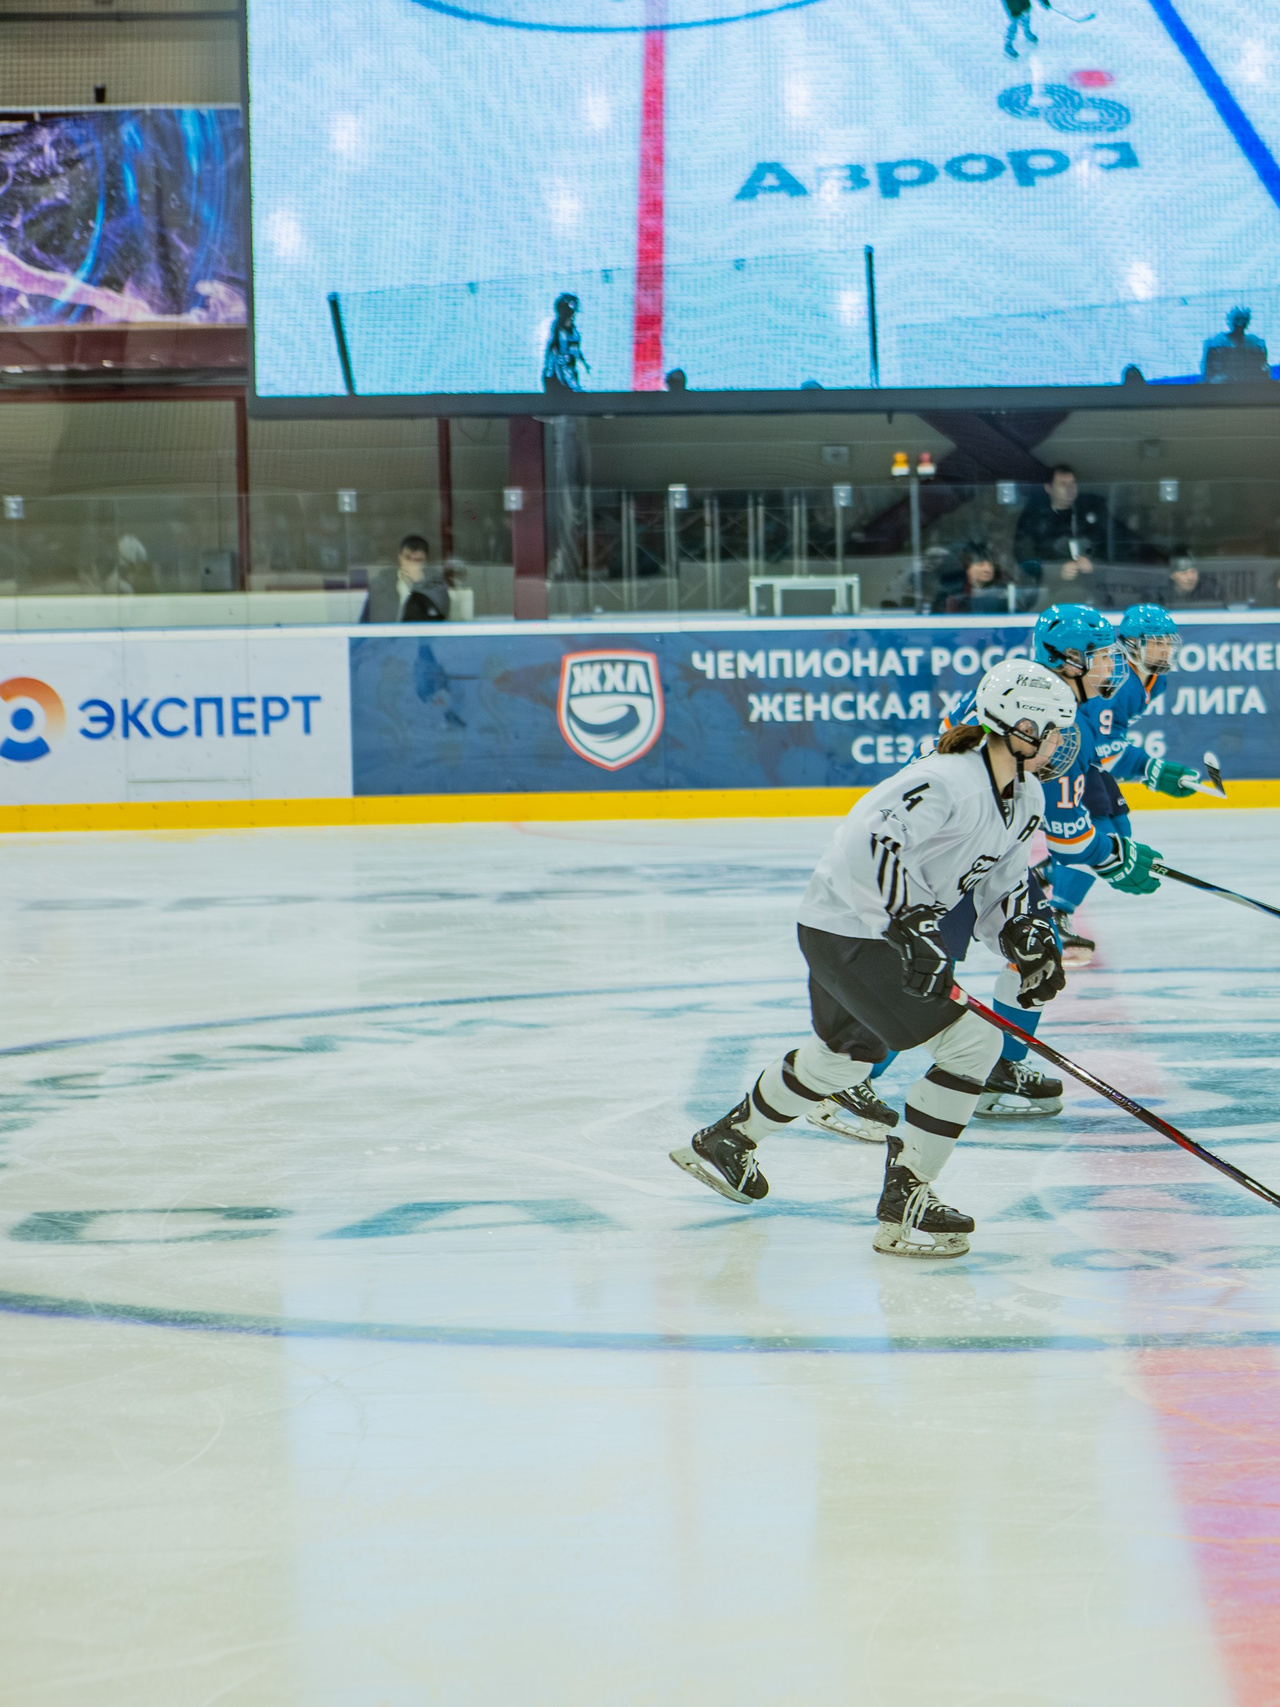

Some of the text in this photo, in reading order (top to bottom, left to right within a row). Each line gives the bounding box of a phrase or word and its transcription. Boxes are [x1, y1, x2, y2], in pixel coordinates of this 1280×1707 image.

[570, 661, 652, 696] ЖХЛ
[692, 647, 925, 680] ЧЕМПИОНАТ
[77, 695, 322, 740] ЭКСПЕРТ
[747, 691, 930, 722] ЖЕНСКАЯ
[1171, 685, 1268, 716] ЛИГА
[1021, 704, 1046, 713] CCM
[1099, 709, 1114, 736] 9
[902, 782, 931, 813] 4
[1057, 775, 1085, 809] 18
